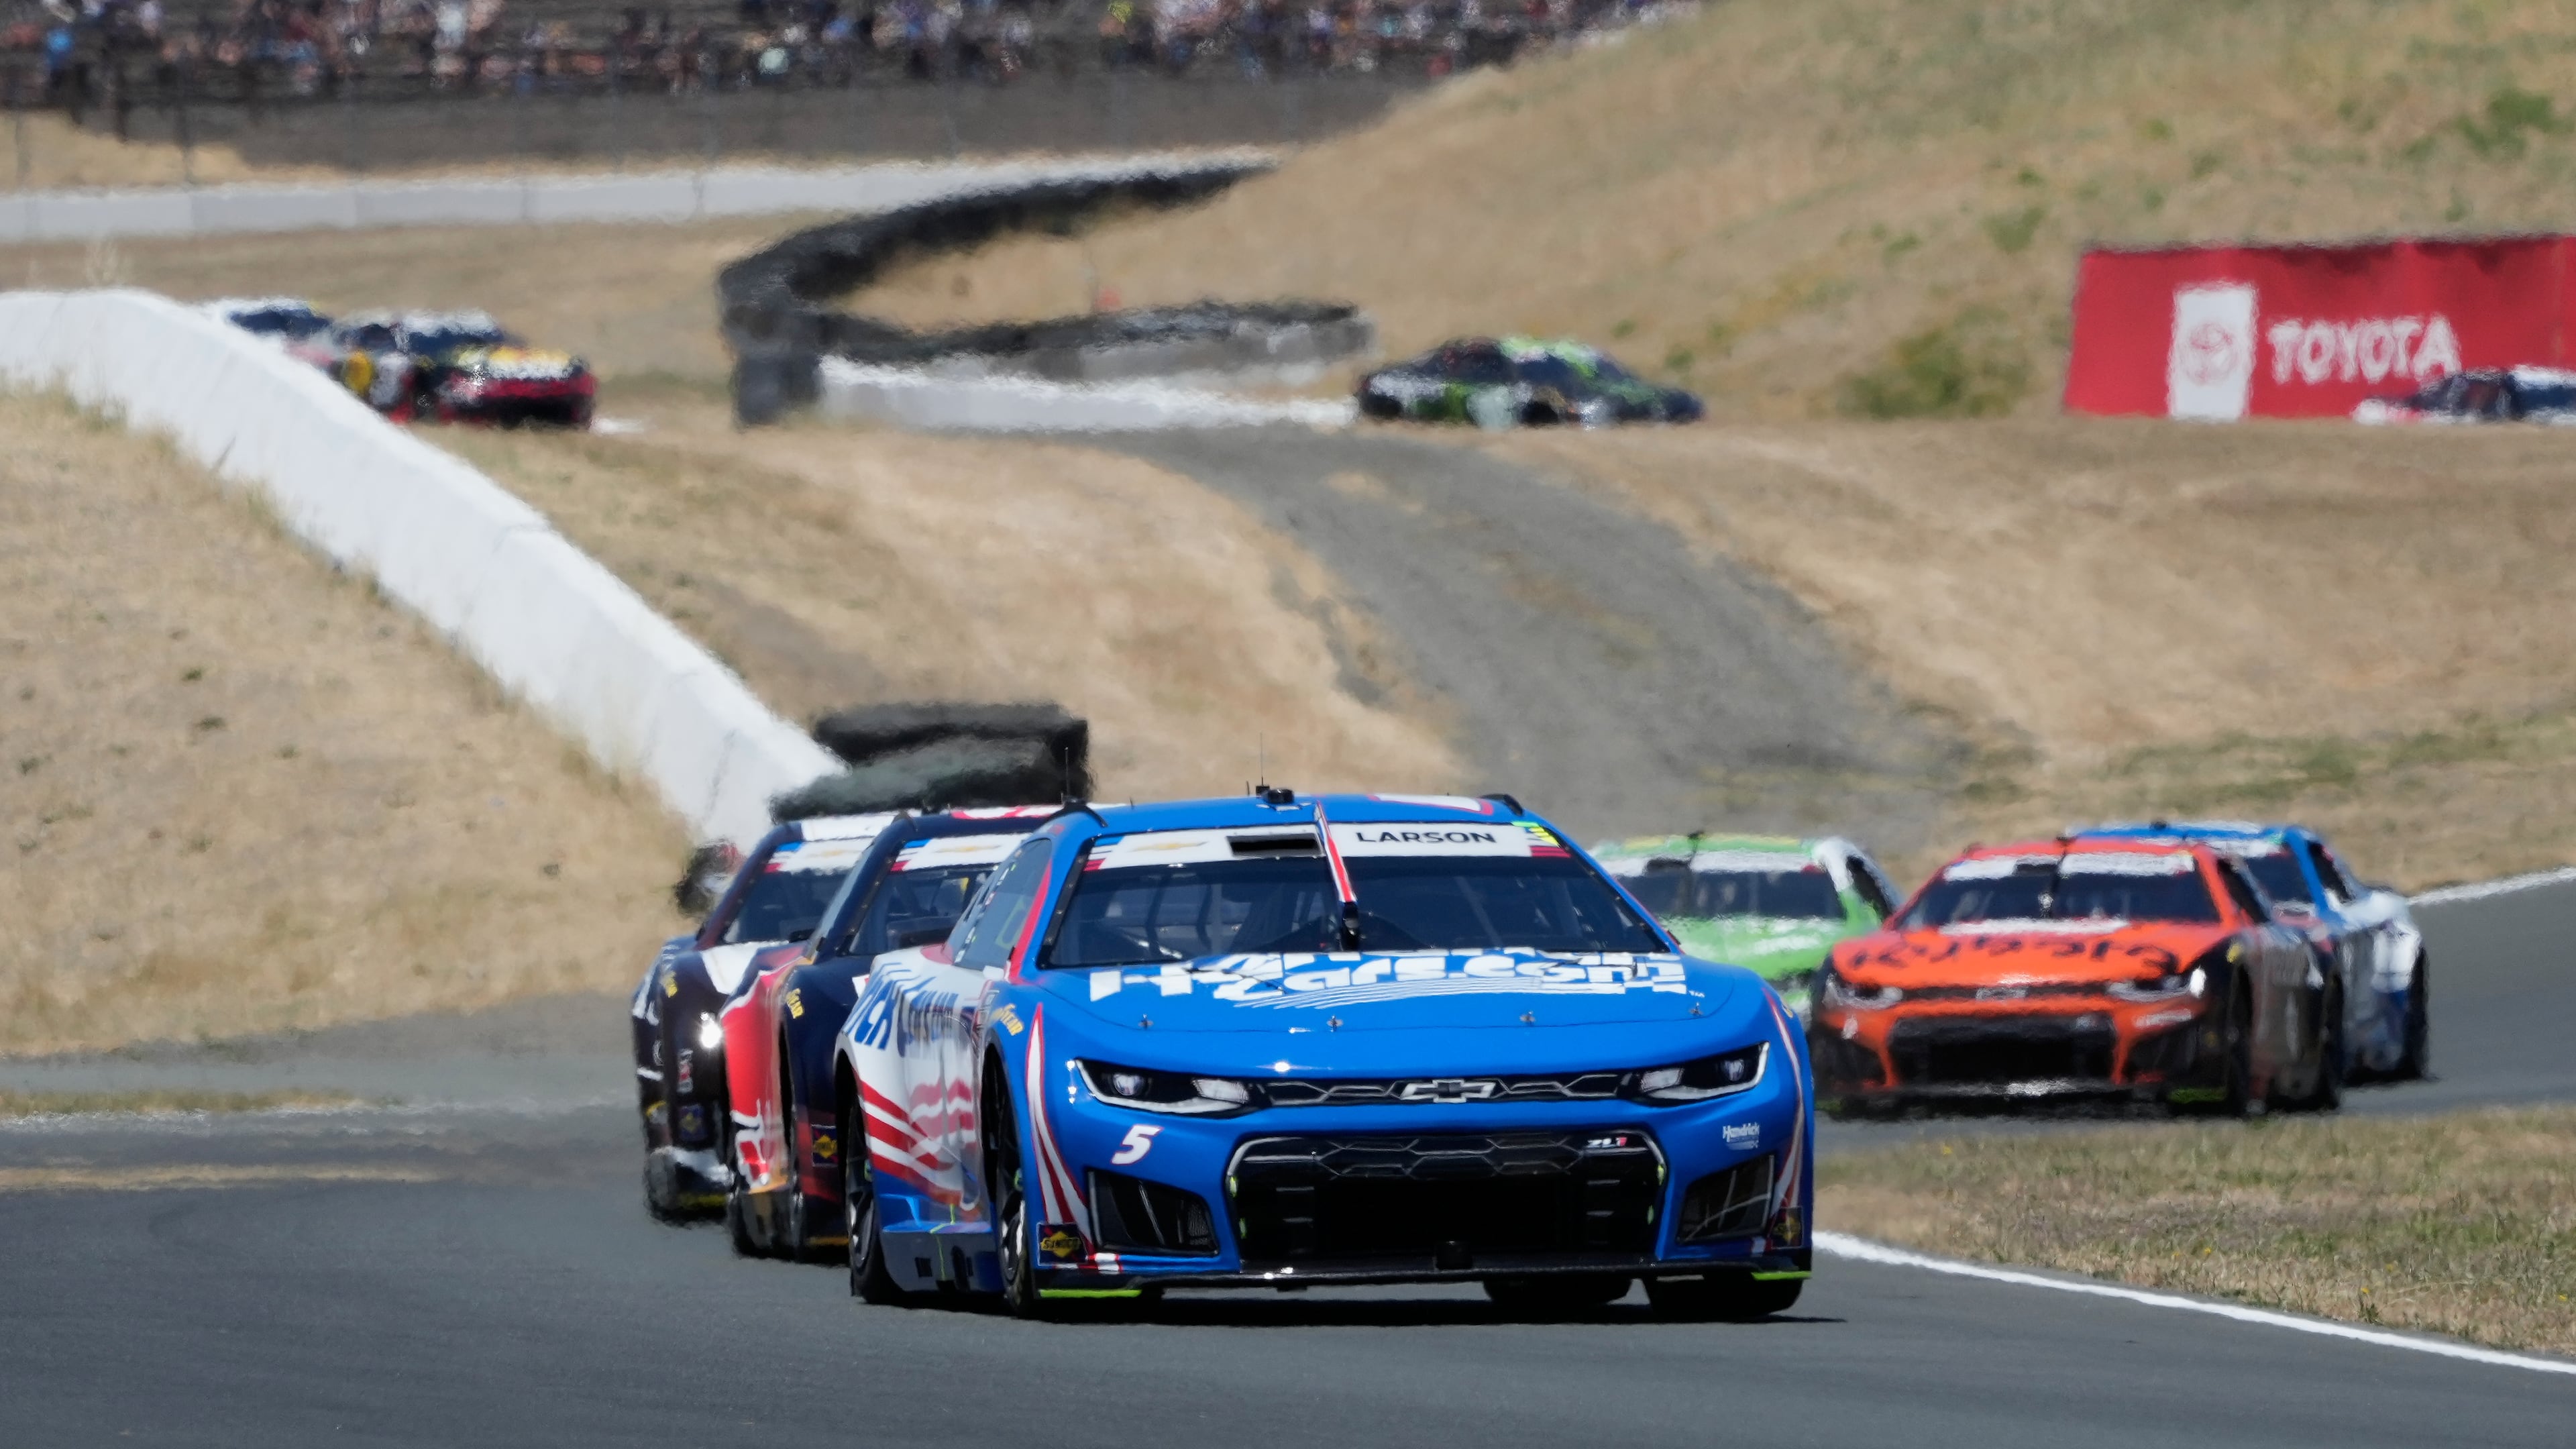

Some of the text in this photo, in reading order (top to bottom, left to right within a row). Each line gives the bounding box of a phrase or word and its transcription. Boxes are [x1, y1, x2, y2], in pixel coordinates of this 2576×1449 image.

[2268, 314, 2461, 384] TOYOTA
[1356, 831, 1497, 843] LARSON
[1110, 1124, 1165, 1165] 5
